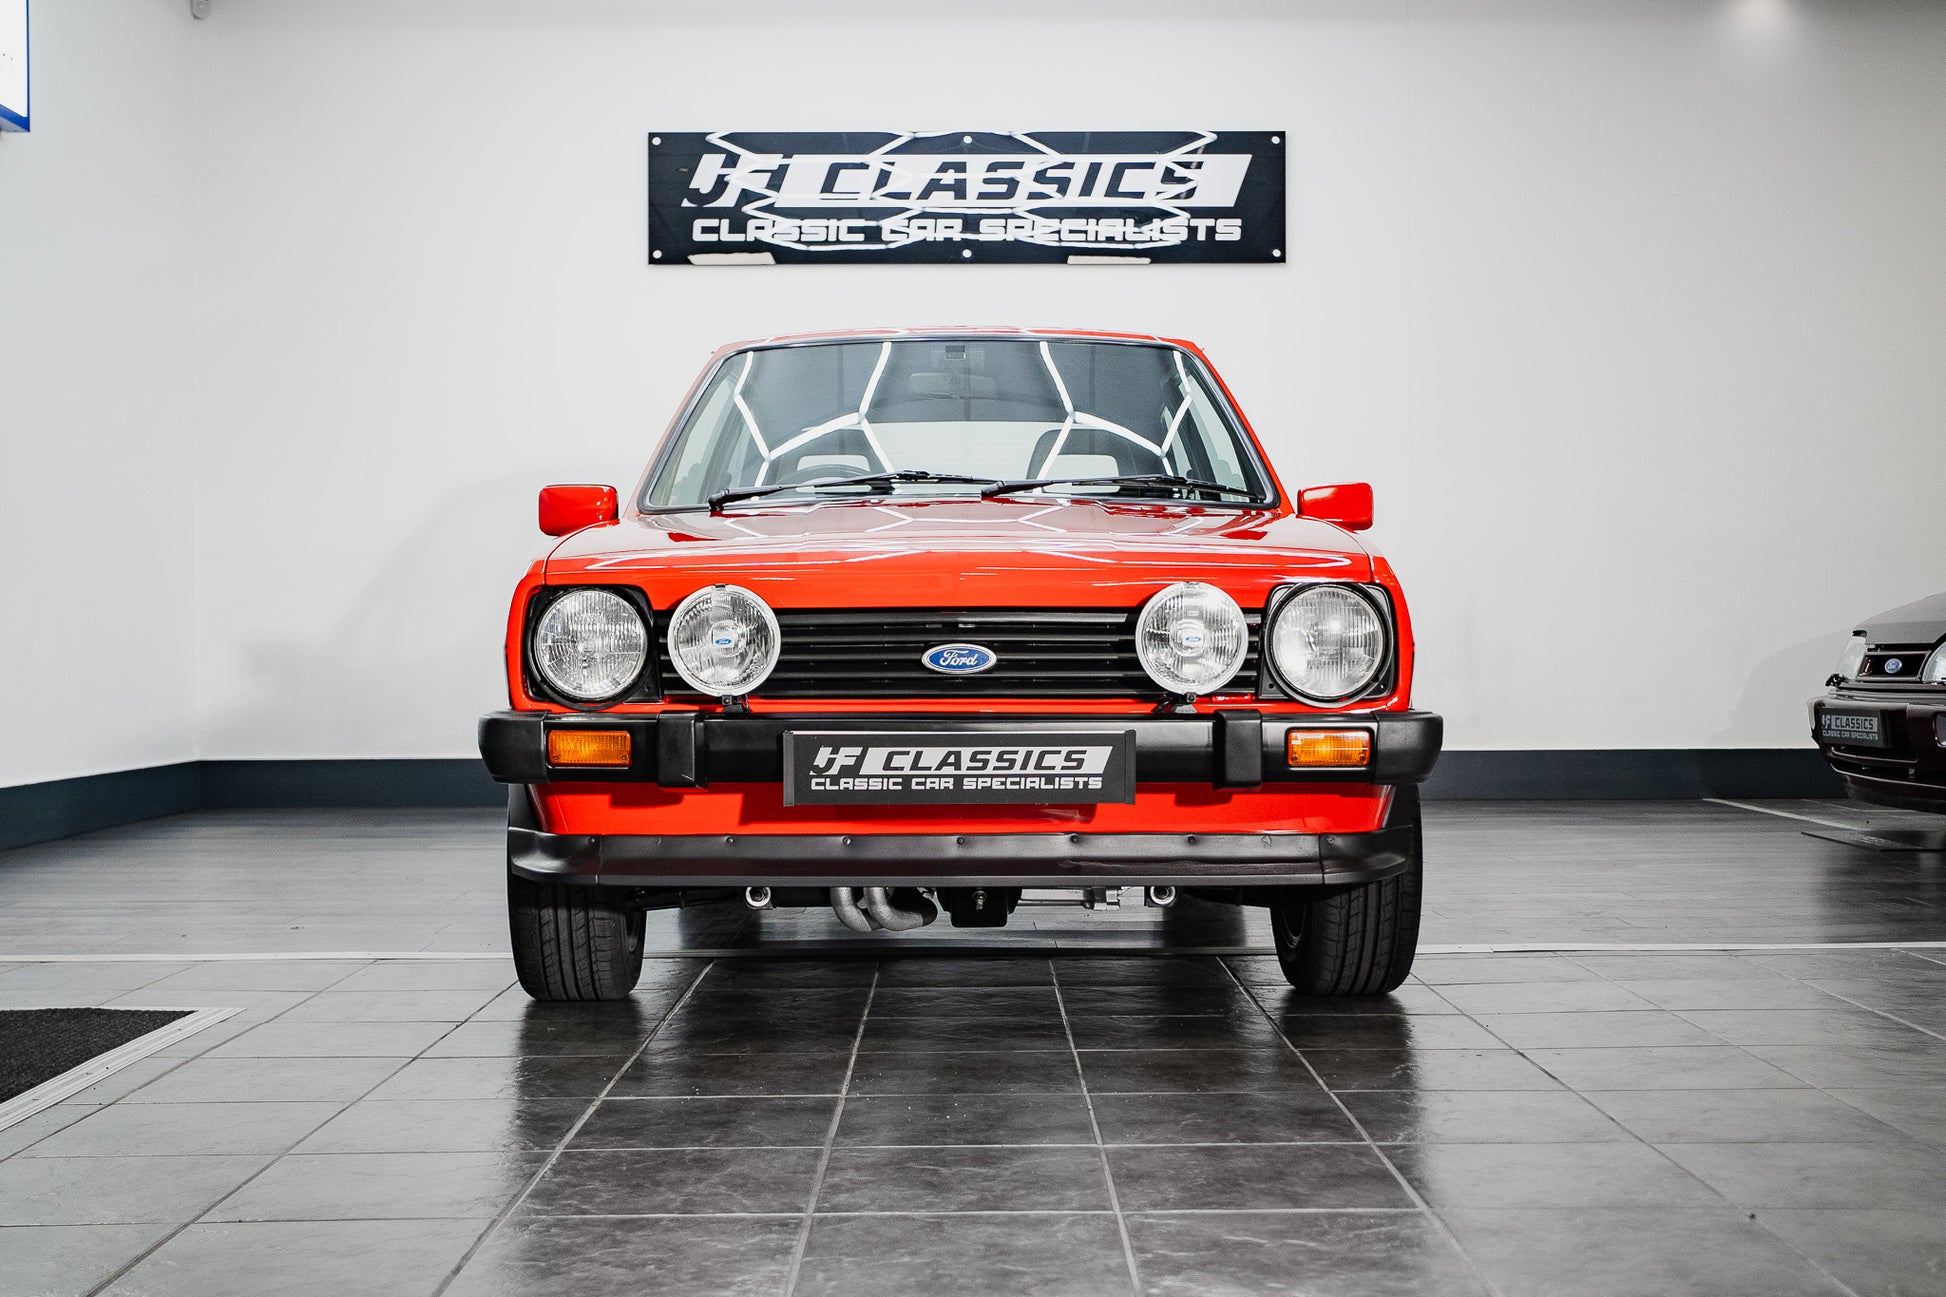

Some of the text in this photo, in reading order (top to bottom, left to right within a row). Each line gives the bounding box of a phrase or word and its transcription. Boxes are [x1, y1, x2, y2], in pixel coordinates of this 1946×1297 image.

[819, 160, 1206, 201] CLASSICS
[692, 218, 1242, 242] CLASSIC CAR SPECIALISTS
[940, 649, 979, 666] Ford
[1834, 717, 1874, 730] CLASSICS
[881, 749, 1088, 772] CLASSICS
[810, 776, 1103, 791] CLASSIC CAR SPECIALISTS
